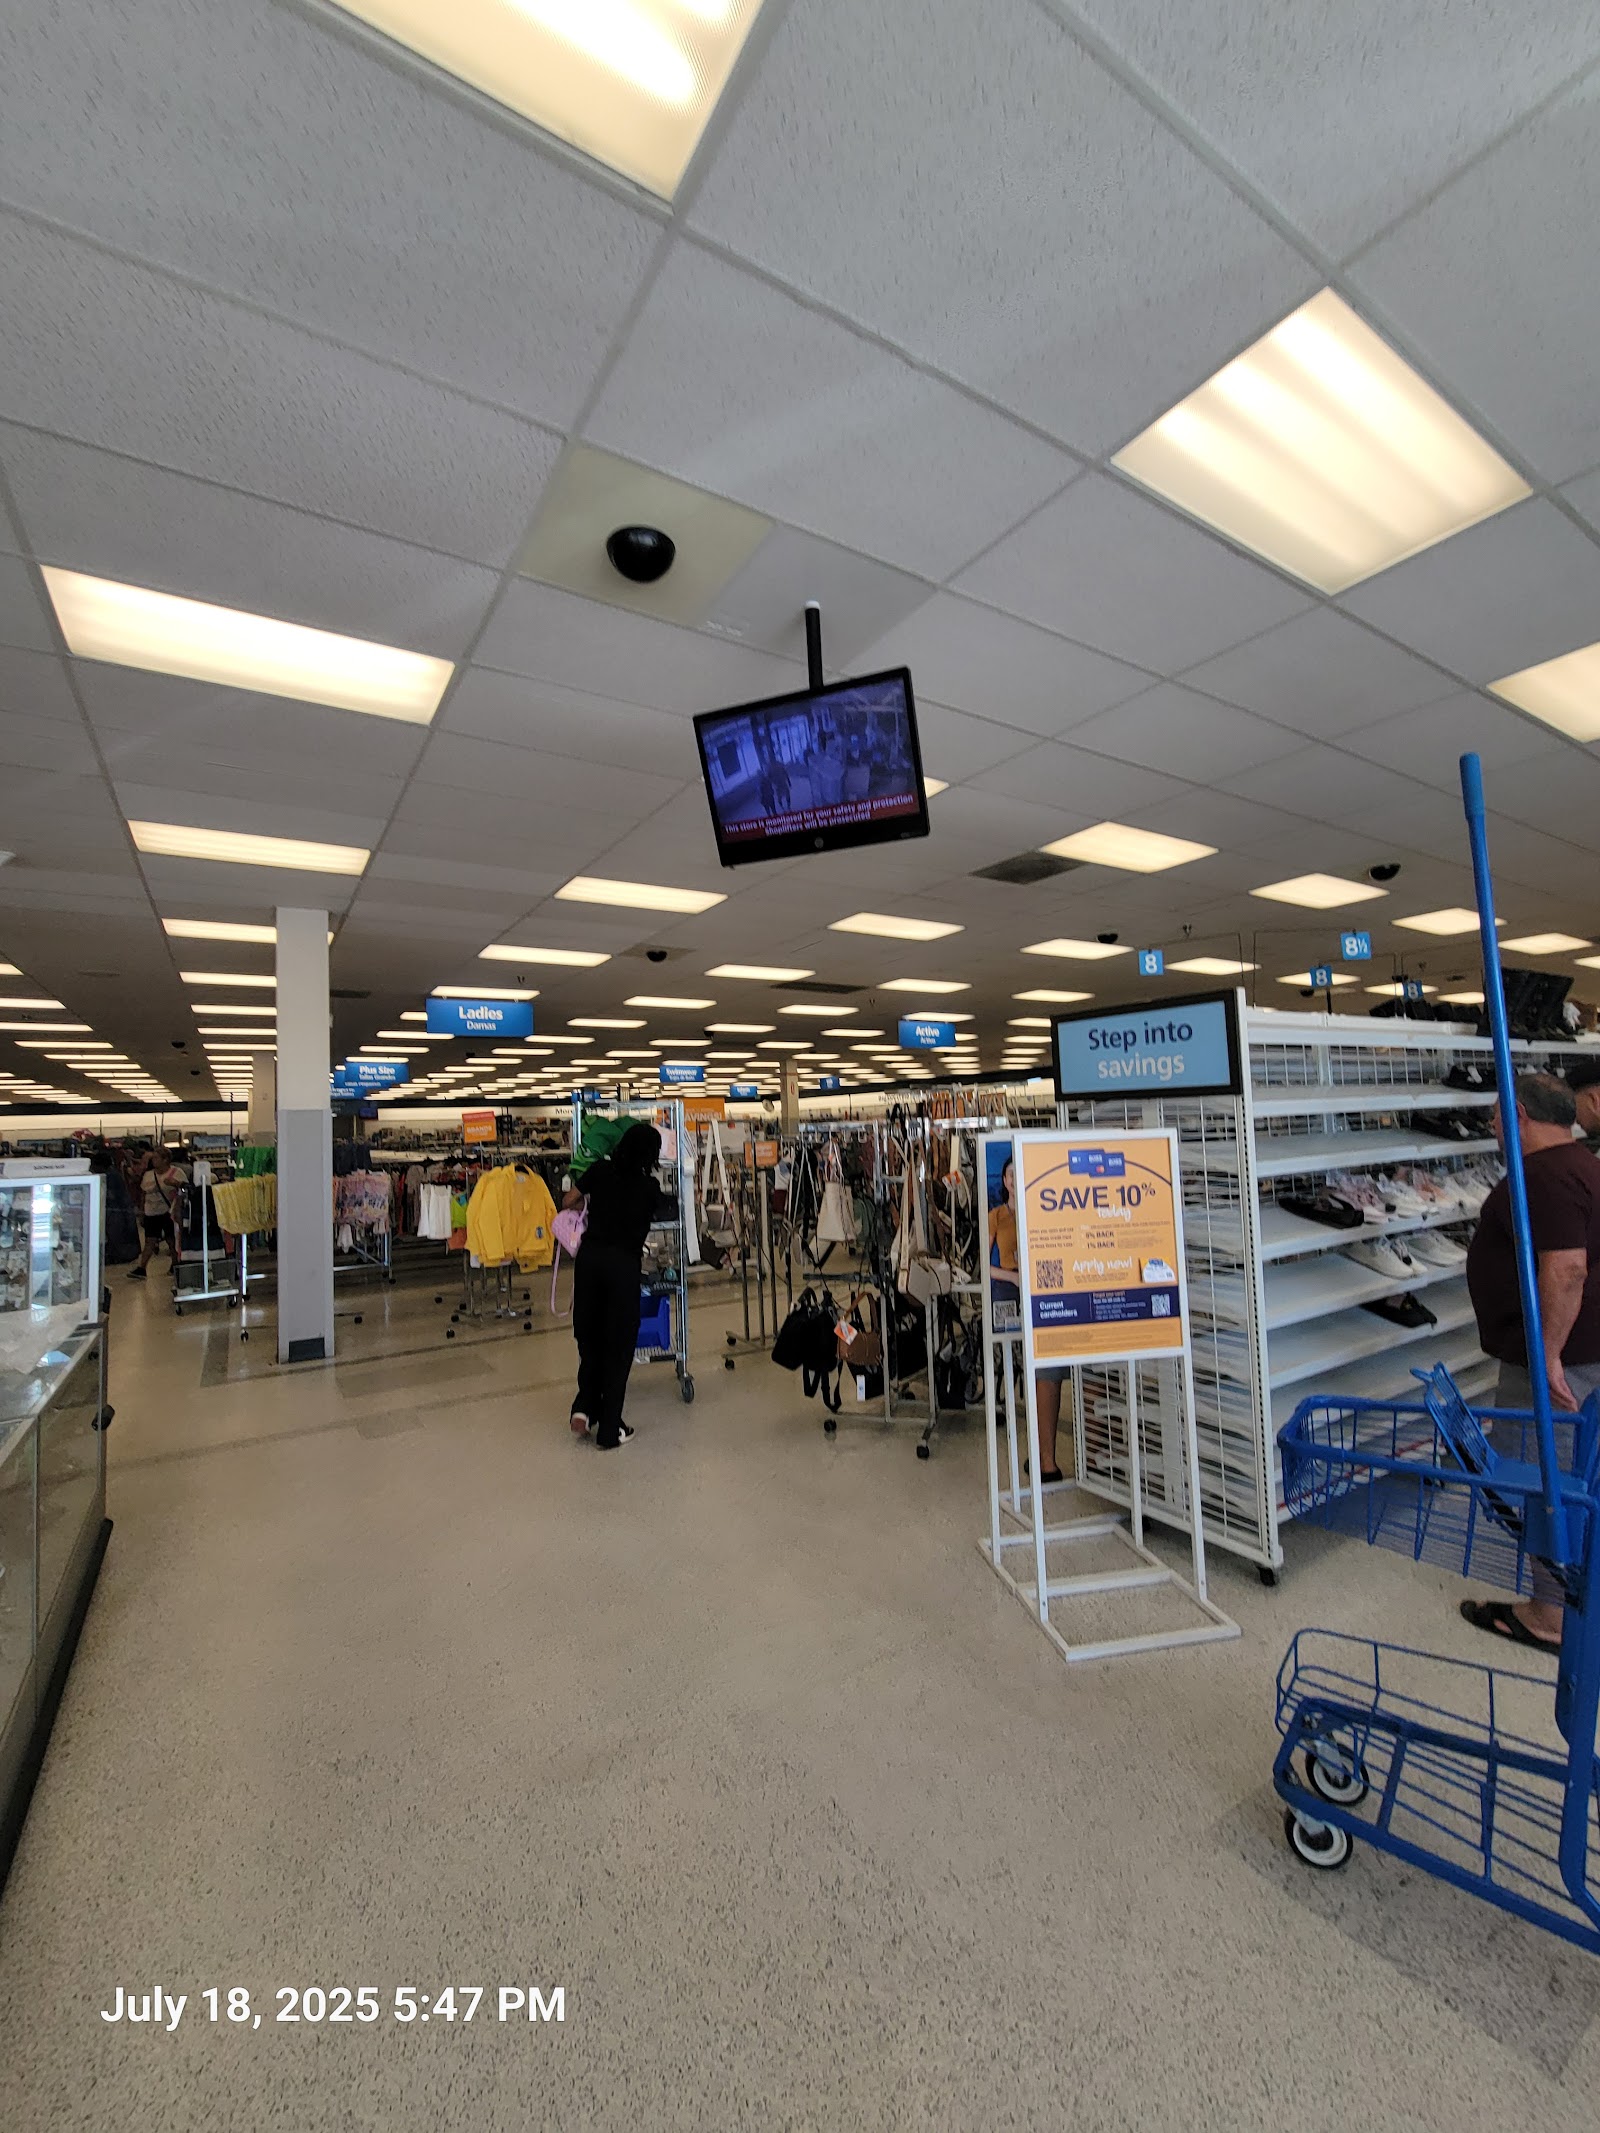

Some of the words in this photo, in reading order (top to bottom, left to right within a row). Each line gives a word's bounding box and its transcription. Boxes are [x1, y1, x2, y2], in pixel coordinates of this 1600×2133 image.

[725, 824, 739, 835] This
[740, 821, 758, 832] store
[765, 814, 802, 828] monitored
[803, 811, 815, 820] for
[815, 810, 832, 822] your
[833, 806, 855, 818] safety
[857, 802, 872, 812] and
[873, 795, 913, 811] protection
[765, 824, 803, 837] Shoplifters
[804, 821, 818, 830] will
[819, 819, 828, 828] be
[829, 811, 871, 827] prosecuted
[1145, 953, 1157, 974] 8
[1315, 968, 1326, 986] 8
[1407, 982, 1418, 998] 8
[458, 1005, 504, 1020] Ladies
[466, 1020, 497, 1031] Damas
[915, 1025, 940, 1038] Active
[1088, 1027, 1137, 1053] Step
[1144, 1020, 1193, 1045] into
[359, 1065, 377, 1074] Plus
[378, 1065, 396, 1075] Size
[666, 1067, 698, 1076] Swimwear
[1098, 1052, 1186, 1082] savings
[1039, 1185, 1109, 1212] SAVE
[1116, 1182, 1156, 1207] 10%
[1096, 1203, 1131, 1222] today
[1096, 1230, 1114, 1239] BACK
[1097, 1241, 1115, 1249] BACK
[1073, 1257, 1105, 1276] Apply
[1107, 1256, 1133, 1270] now!
[1039, 1301, 1064, 1310] Current
[1040, 1309, 1078, 1320] cardholders
